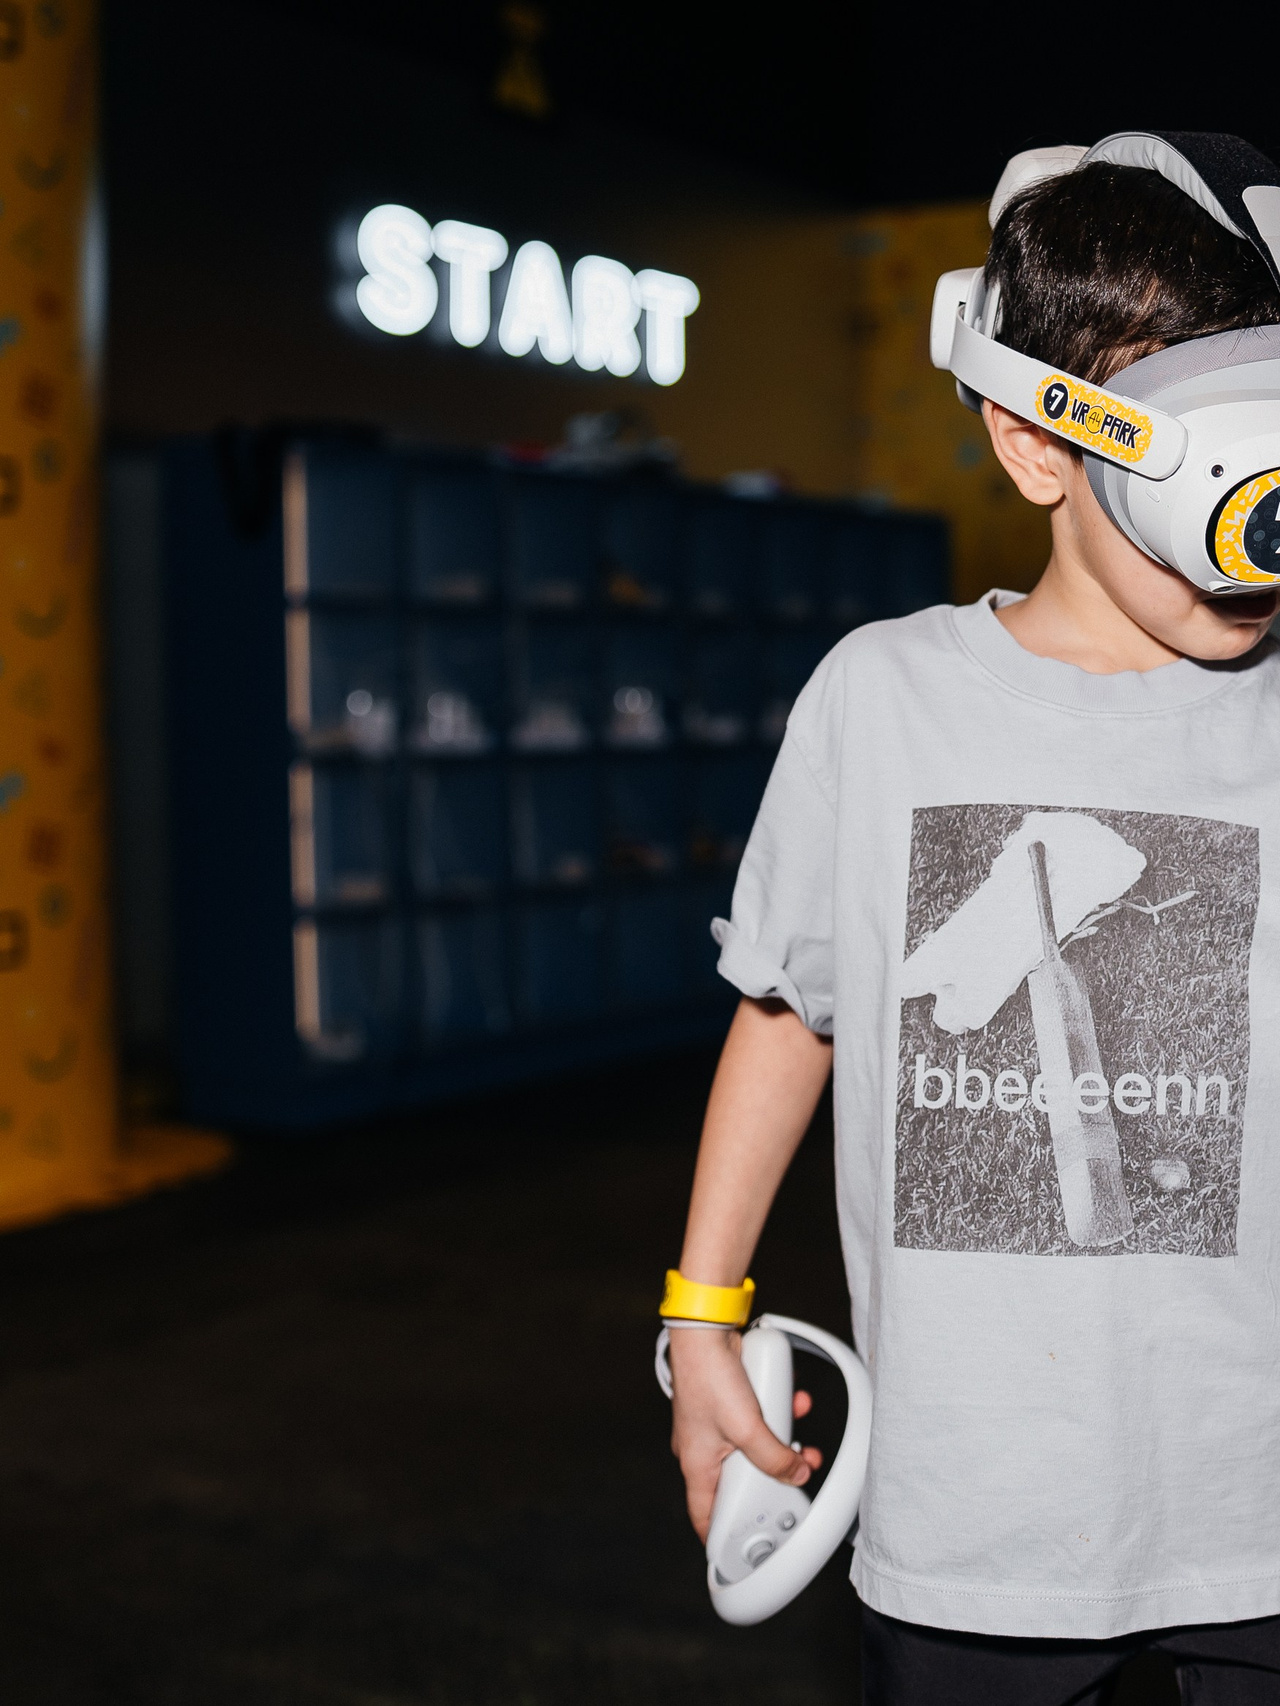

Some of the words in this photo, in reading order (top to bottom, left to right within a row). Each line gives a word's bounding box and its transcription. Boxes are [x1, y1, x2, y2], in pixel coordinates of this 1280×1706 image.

[356, 204, 700, 386] START
[1050, 388, 1065, 412] 7
[1071, 398, 1090, 425] VR
[1100, 413, 1142, 449] PARK
